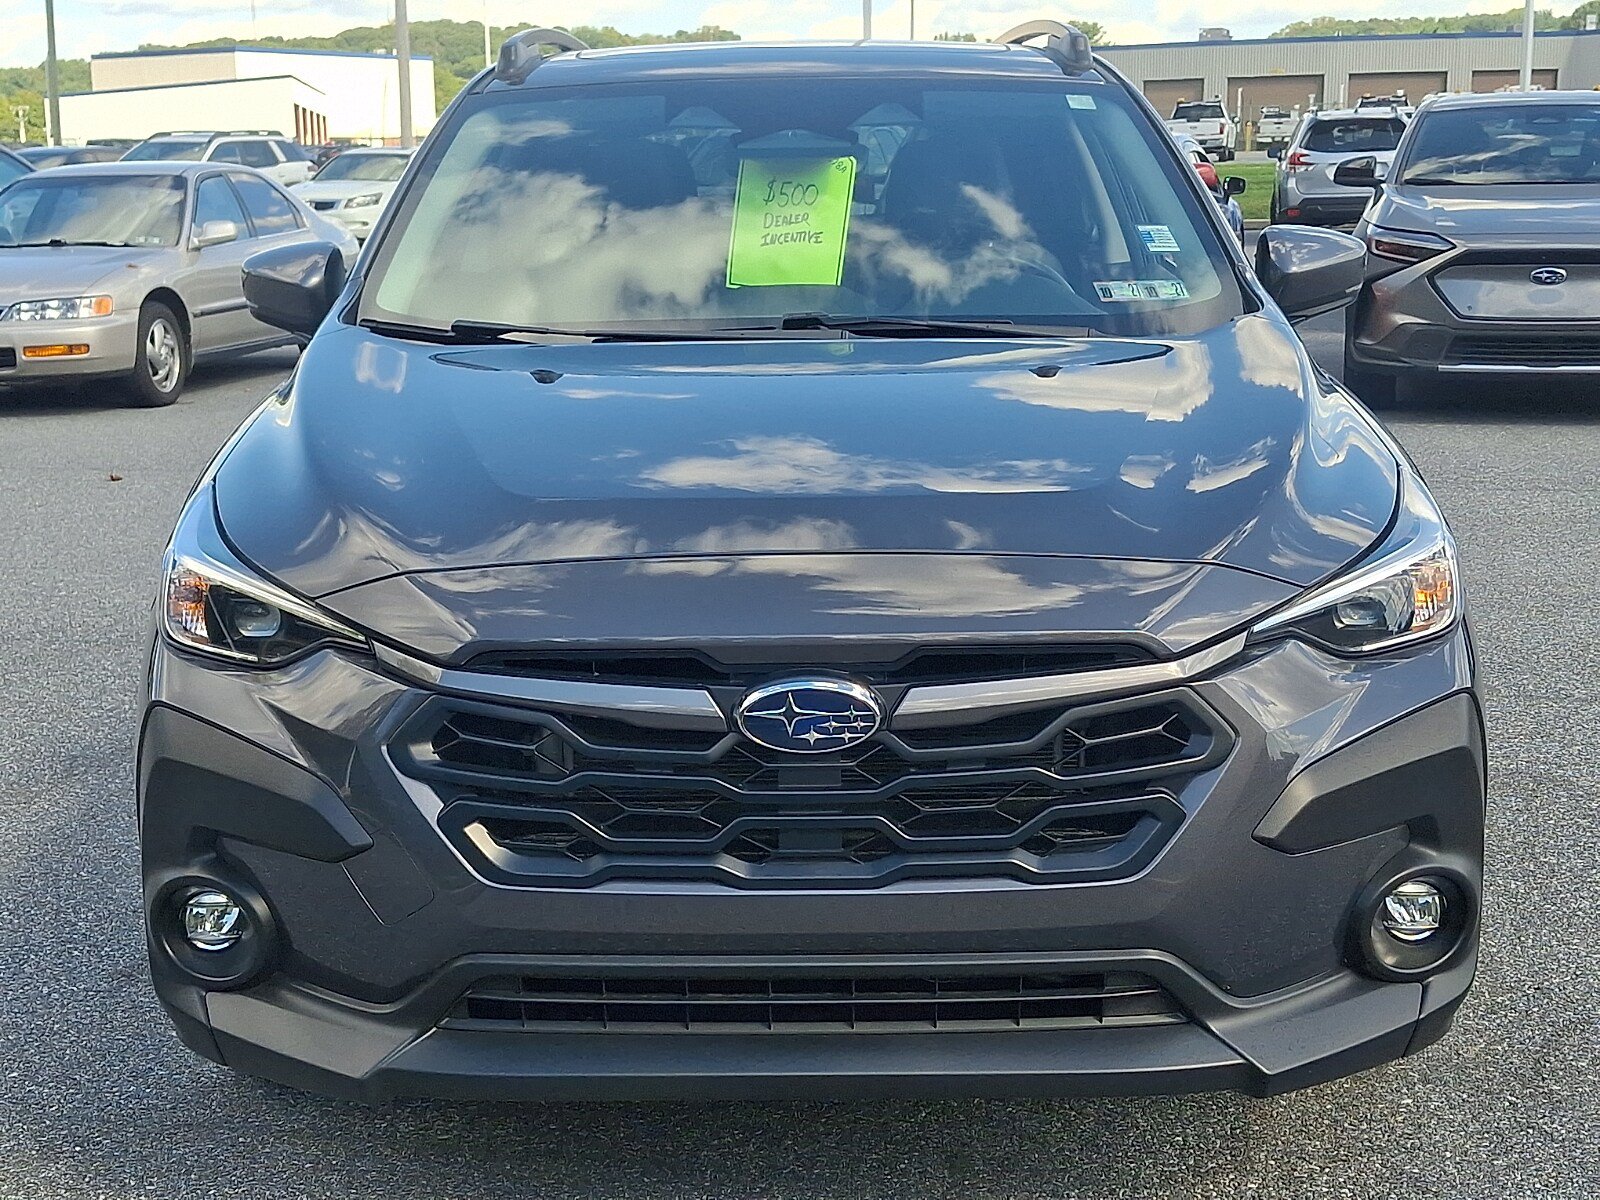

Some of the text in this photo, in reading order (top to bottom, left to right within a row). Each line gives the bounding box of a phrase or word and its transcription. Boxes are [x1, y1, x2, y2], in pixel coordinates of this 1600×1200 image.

[763, 176, 819, 208] $500
[763, 212, 811, 229] DEALER
[761, 231, 824, 247] INCENTIVE
[1099, 287, 1114, 299] 10
